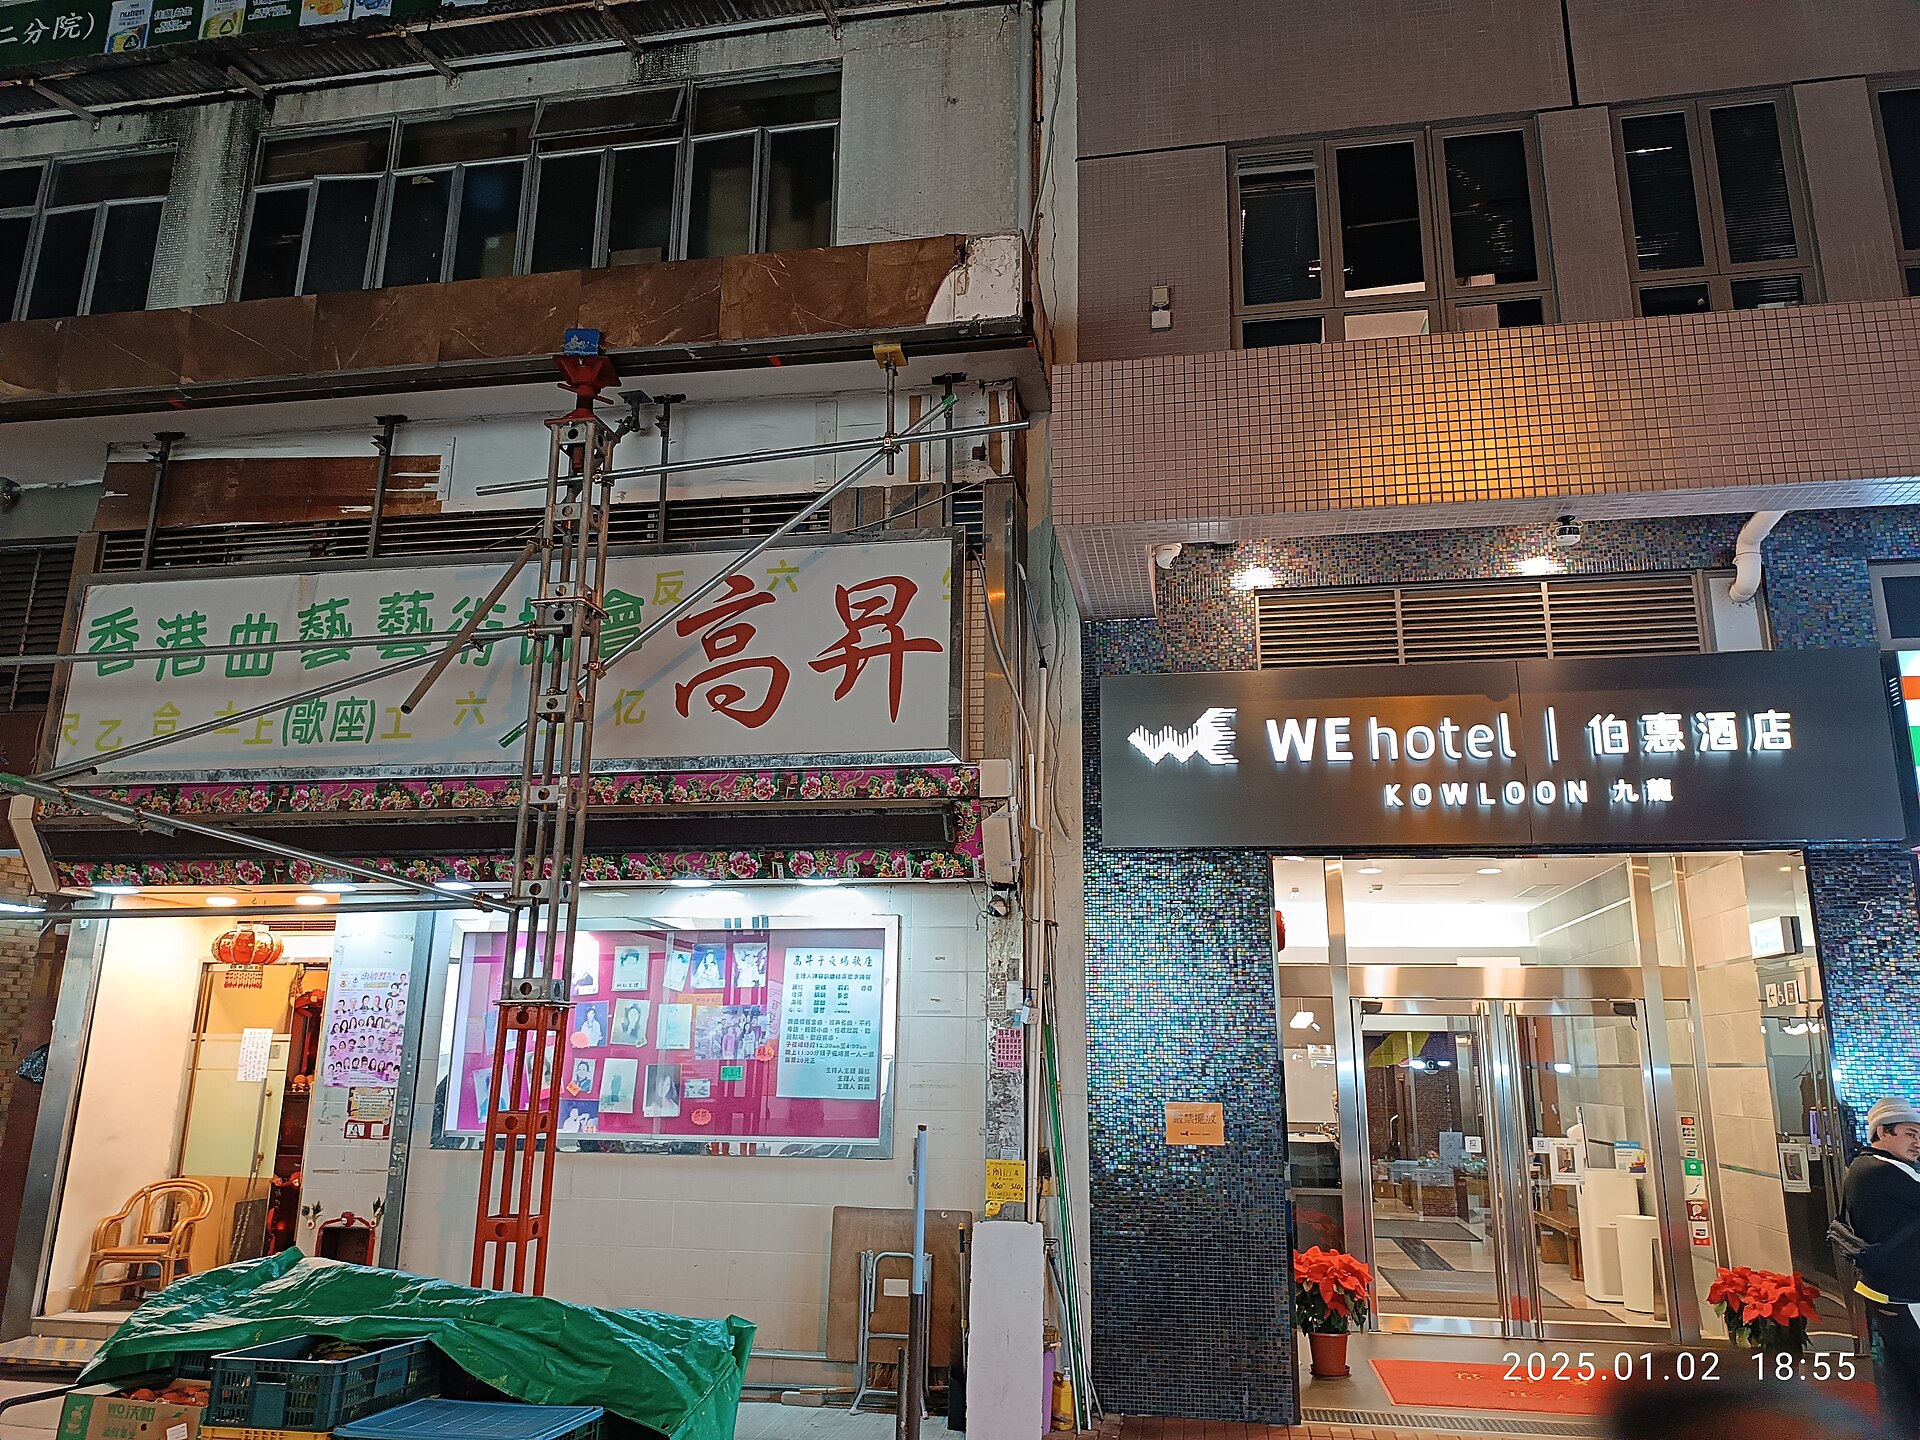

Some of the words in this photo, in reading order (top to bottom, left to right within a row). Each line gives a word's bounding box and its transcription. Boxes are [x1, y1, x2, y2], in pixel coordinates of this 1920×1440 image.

[652, 571, 685, 606] 反
[768, 560, 799, 592] 六
[675, 574, 944, 729] 高昇
[152, 701, 181, 737] 合
[282, 697, 376, 747] (歌座)
[455, 691, 487, 725] 六
[1266, 716, 1354, 763] WE
[1368, 713, 1518, 761] hotel
[1586, 709, 1793, 758] 伯惠酒店
[1384, 780, 1589, 806] KOWLOON
[1611, 777, 1675, 804] 九龍
